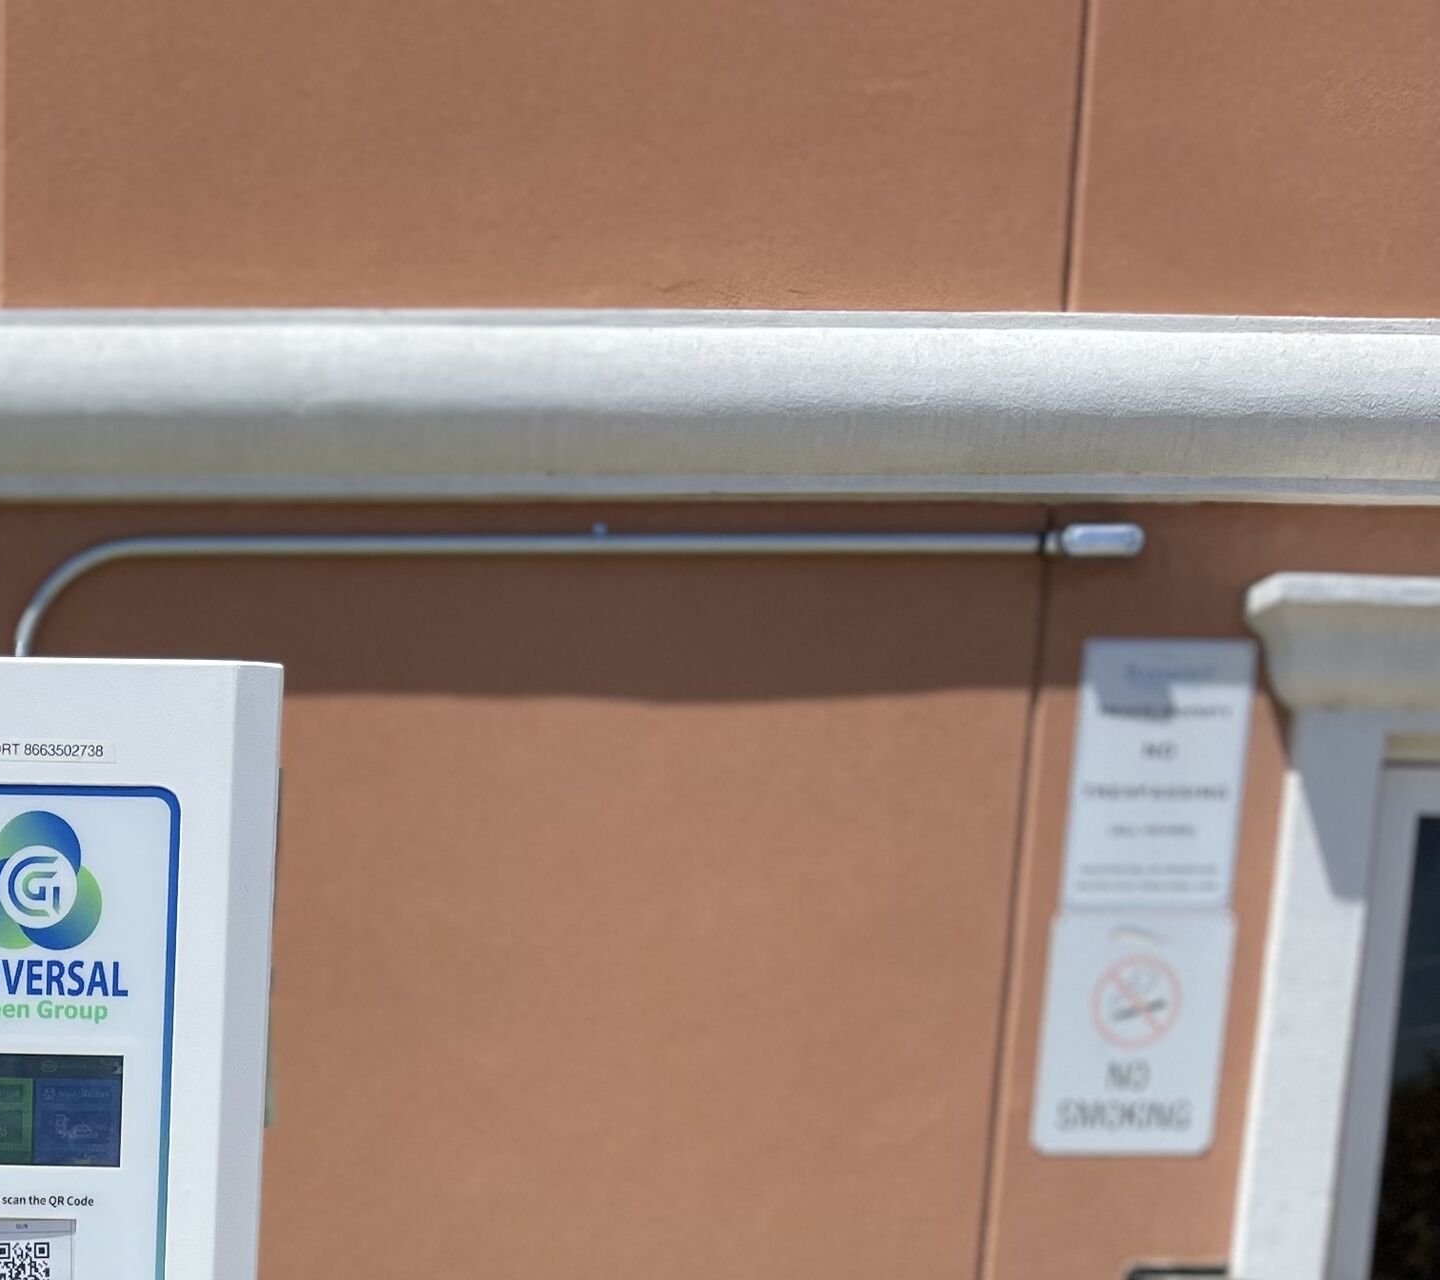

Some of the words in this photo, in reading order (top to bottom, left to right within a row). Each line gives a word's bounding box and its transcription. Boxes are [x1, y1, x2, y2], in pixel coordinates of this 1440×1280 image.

[23, 742, 104, 758] 8663502738
[36, 1000, 109, 1024] Group
[1, 1195, 27, 1206] scan
[28, 1194, 47, 1206] the
[48, 1195, 65, 1208] QR
[66, 1195, 95, 1207] Code
